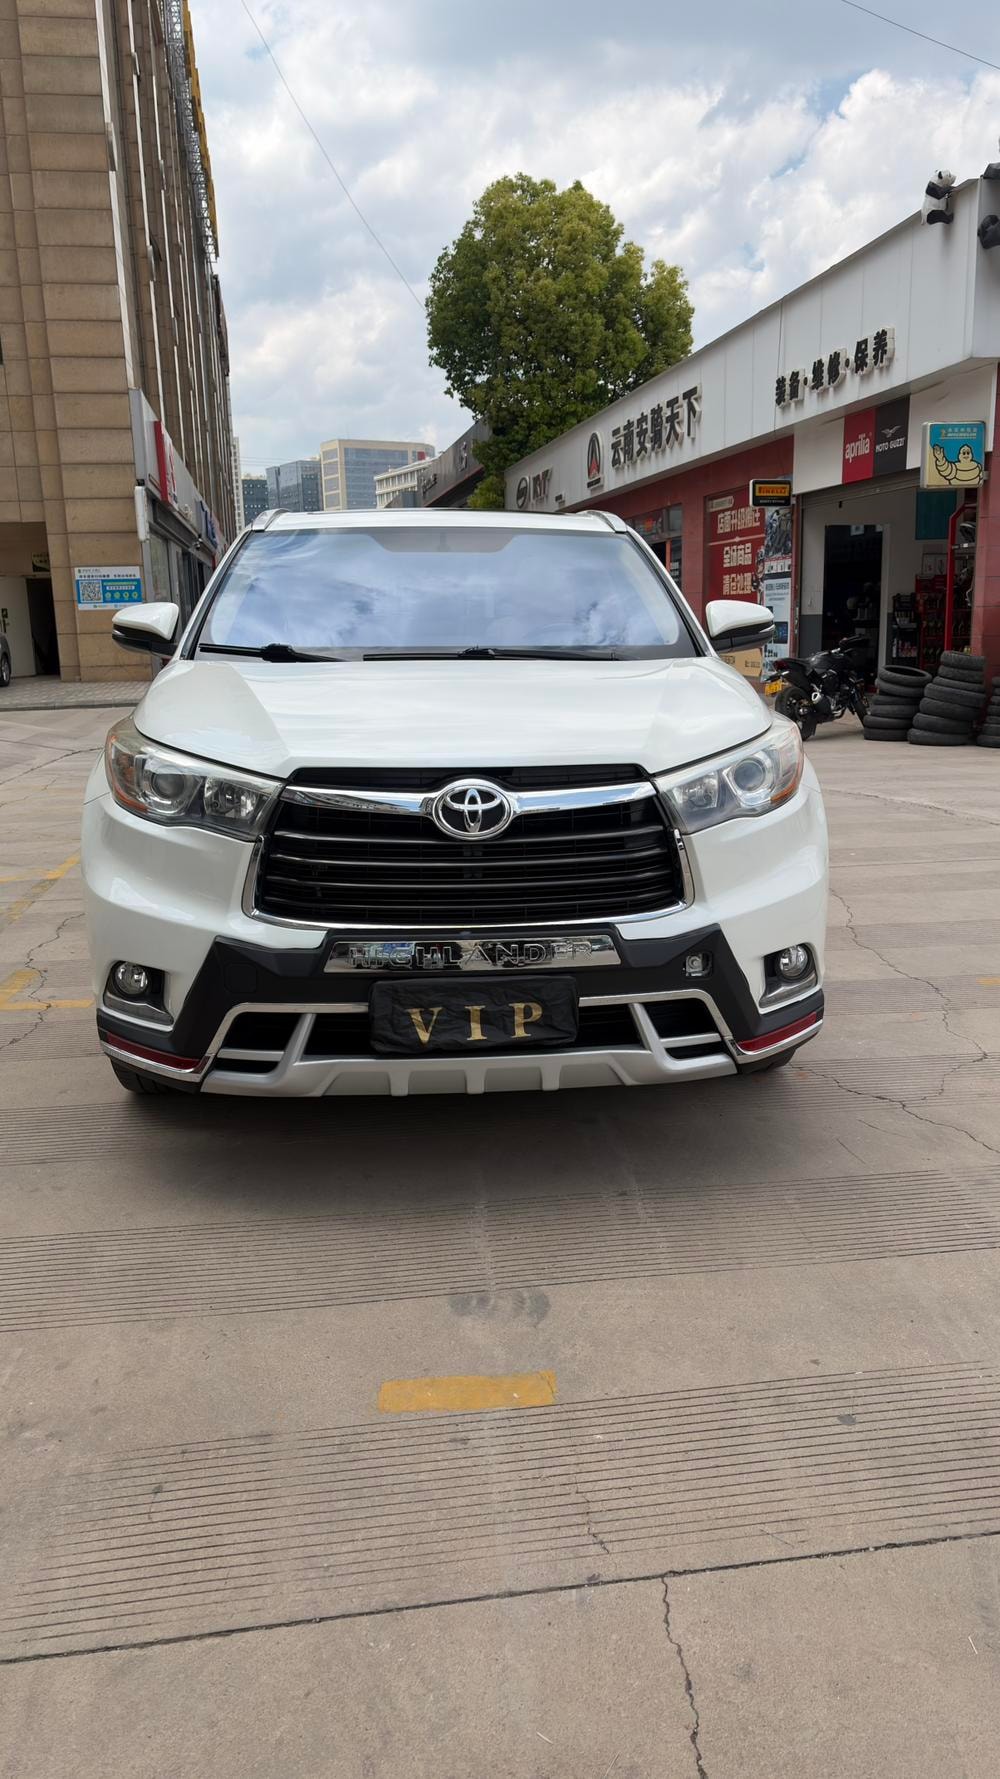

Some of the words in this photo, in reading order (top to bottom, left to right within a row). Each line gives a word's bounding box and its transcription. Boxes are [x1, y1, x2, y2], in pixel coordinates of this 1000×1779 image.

[611, 386, 699, 468] 云南安骑天下
[845, 433, 870, 463] aprilia
[876, 442, 889, 453] MOTO
[349, 939, 594, 970] HIGHLANDER
